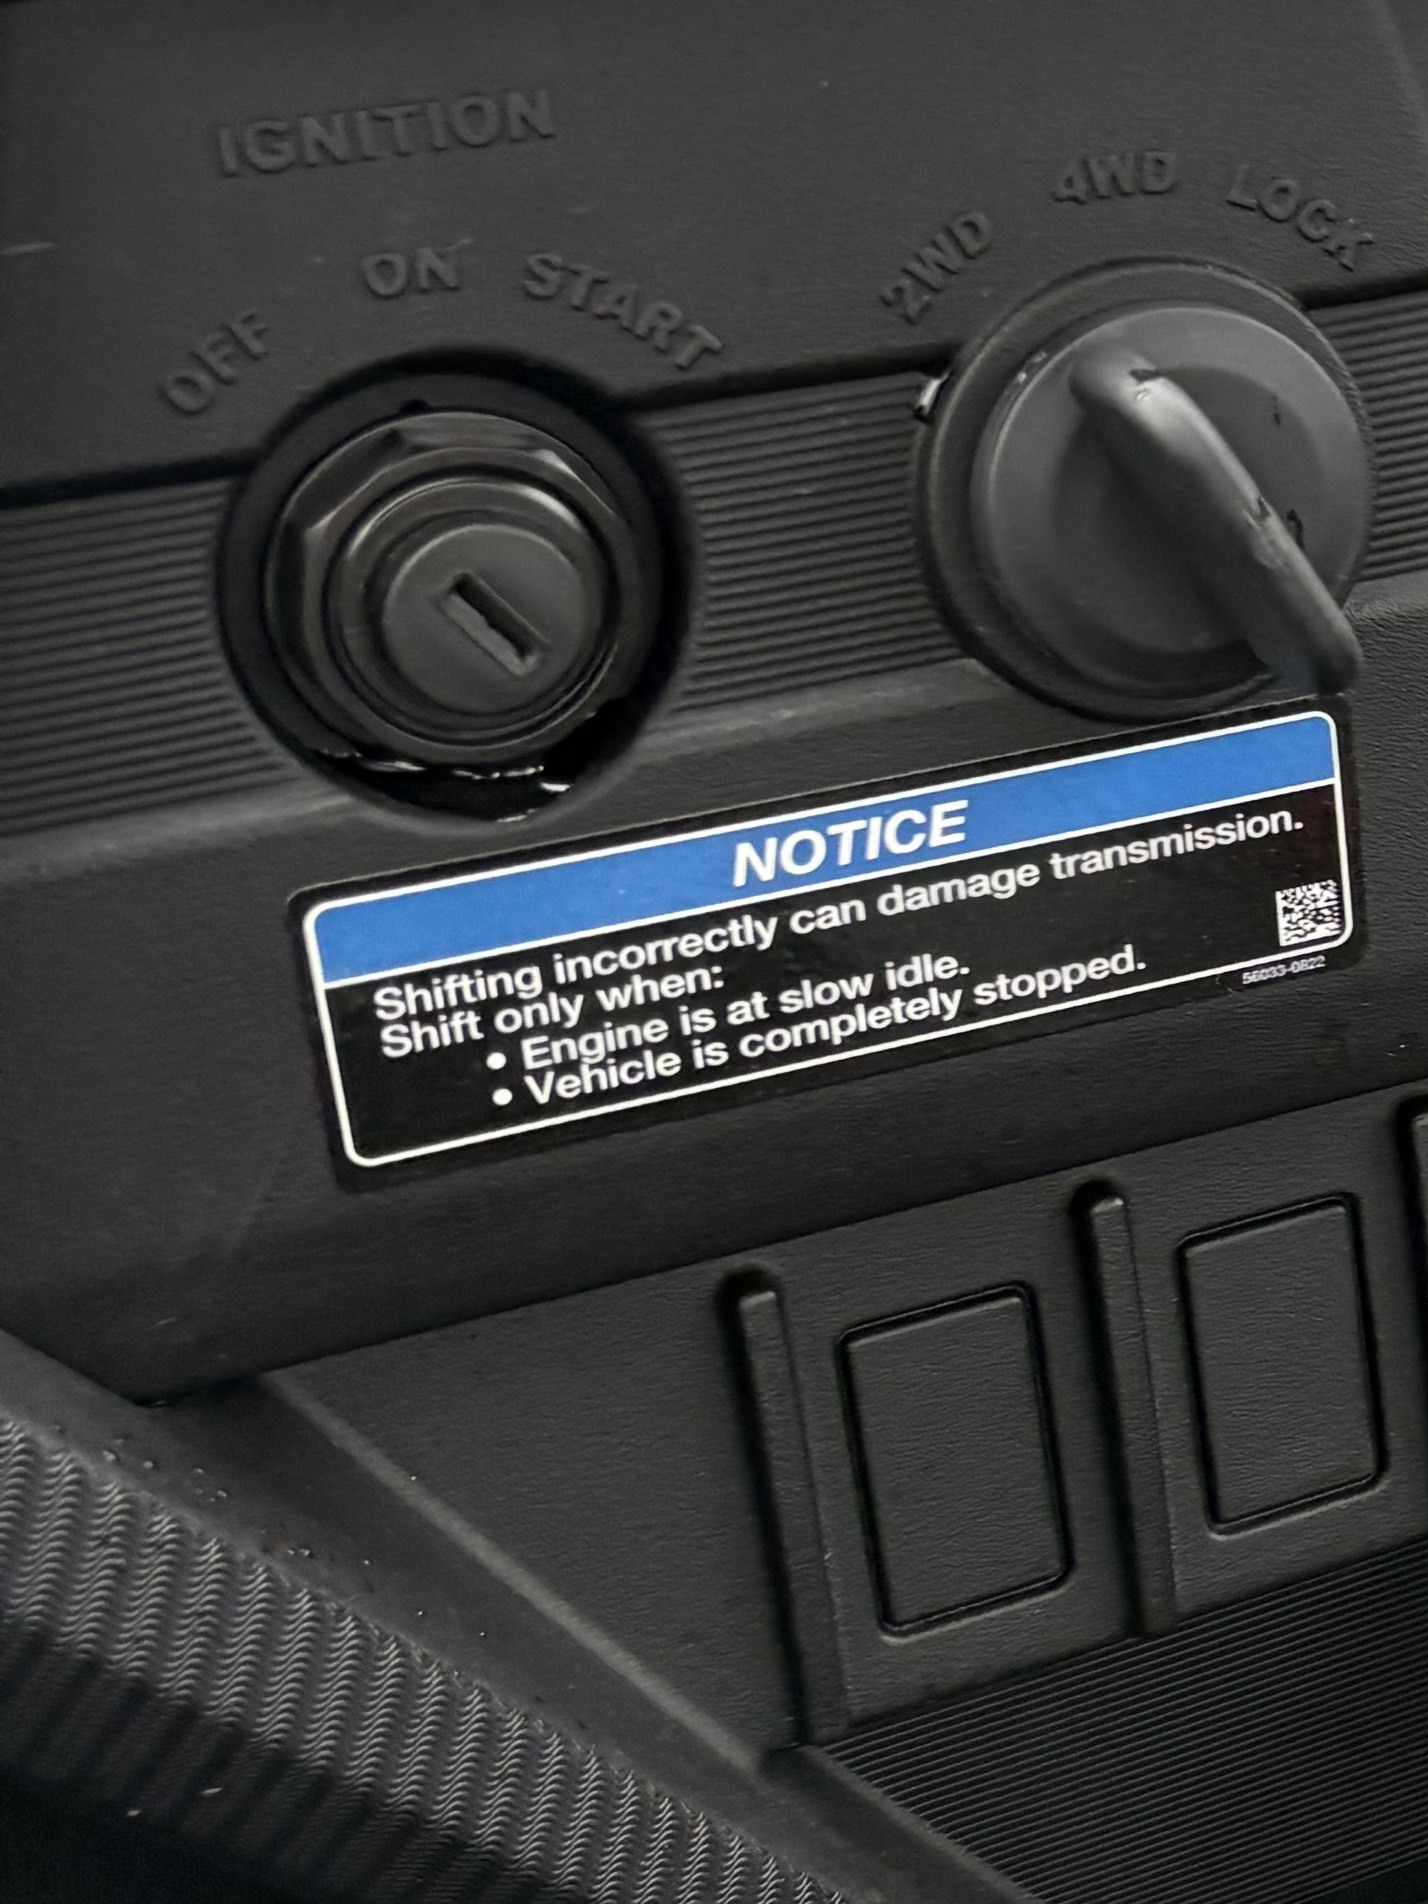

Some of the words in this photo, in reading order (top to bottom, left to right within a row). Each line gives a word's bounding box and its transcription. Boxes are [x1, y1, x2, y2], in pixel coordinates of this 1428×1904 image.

[214, 89, 557, 177] IGNITION
[1051, 149, 1180, 205] 4WD
[361, 245, 461, 298] ON
[876, 210, 994, 326] 2WD
[1225, 163, 1375, 273] LOCK
[161, 310, 270, 415] OFF
[521, 251, 724, 371] START
[732, 799, 969, 888] NOTICE
[373, 962, 543, 1021] Shifting
[553, 912, 778, 985] incorrectly
[789, 898, 867, 937] can
[877, 860, 1040, 919] damage
[1049, 808, 1304, 882] transmission.
[380, 1012, 484, 1059] Shift
[494, 989, 584, 1035] only
[597, 964, 725, 1012] when:
[520, 1017, 670, 1071] Engine
[679, 1003, 717, 1038] is
[726, 992, 769, 1027] at
[778, 971, 875, 1014] slow
[885, 953, 970, 993] idle.
[524, 1049, 682, 1106] Vehicle
[692, 1037, 729, 1072] is
[738, 985, 962, 1061] completely
[973, 943, 1147, 1006] stopped.
